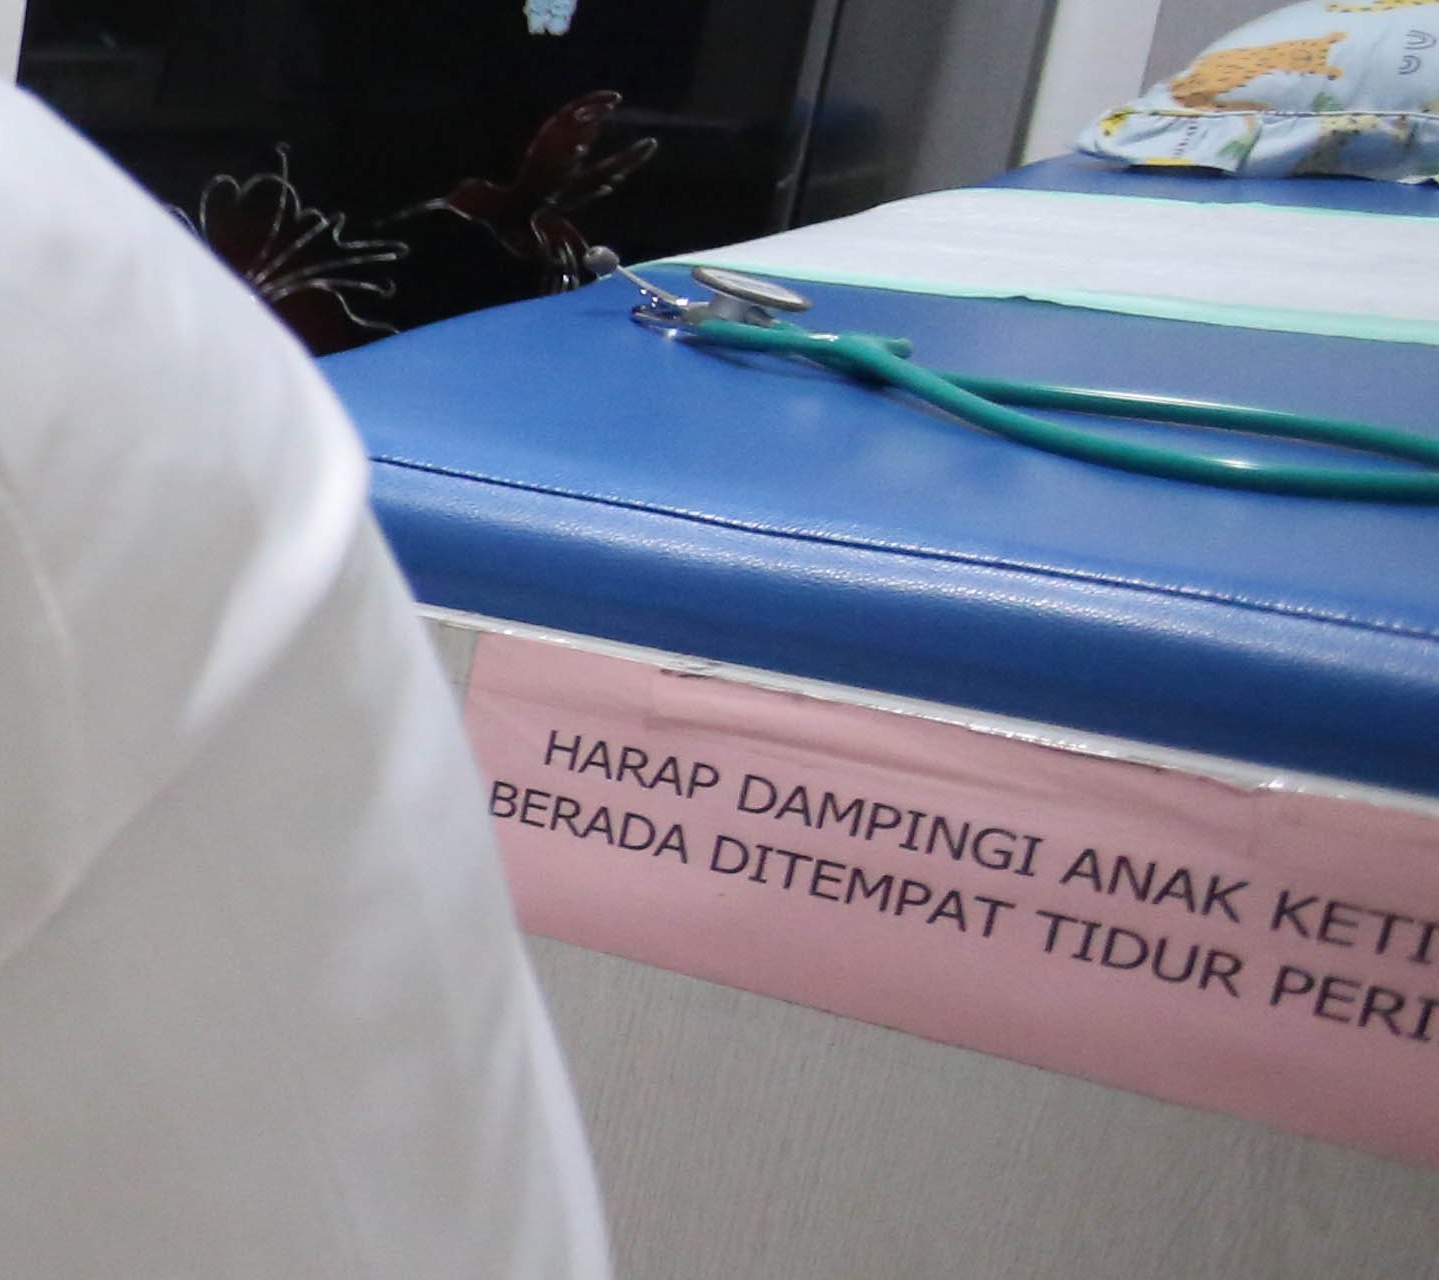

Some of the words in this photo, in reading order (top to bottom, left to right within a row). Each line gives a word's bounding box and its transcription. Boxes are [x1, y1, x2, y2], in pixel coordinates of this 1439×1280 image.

[488, 780, 690, 865] BERADA
[709, 834, 1016, 941] DITEMPAT
[1036, 908, 1244, 998] TIDUR
[1269, 966, 1439, 1047] PERI
[543, 729, 720, 798] HARAP
[736, 772, 1047, 880] DAMPINGI
[1060, 846, 1249, 923] ANAK
[1269, 889, 1439, 967] KETI
